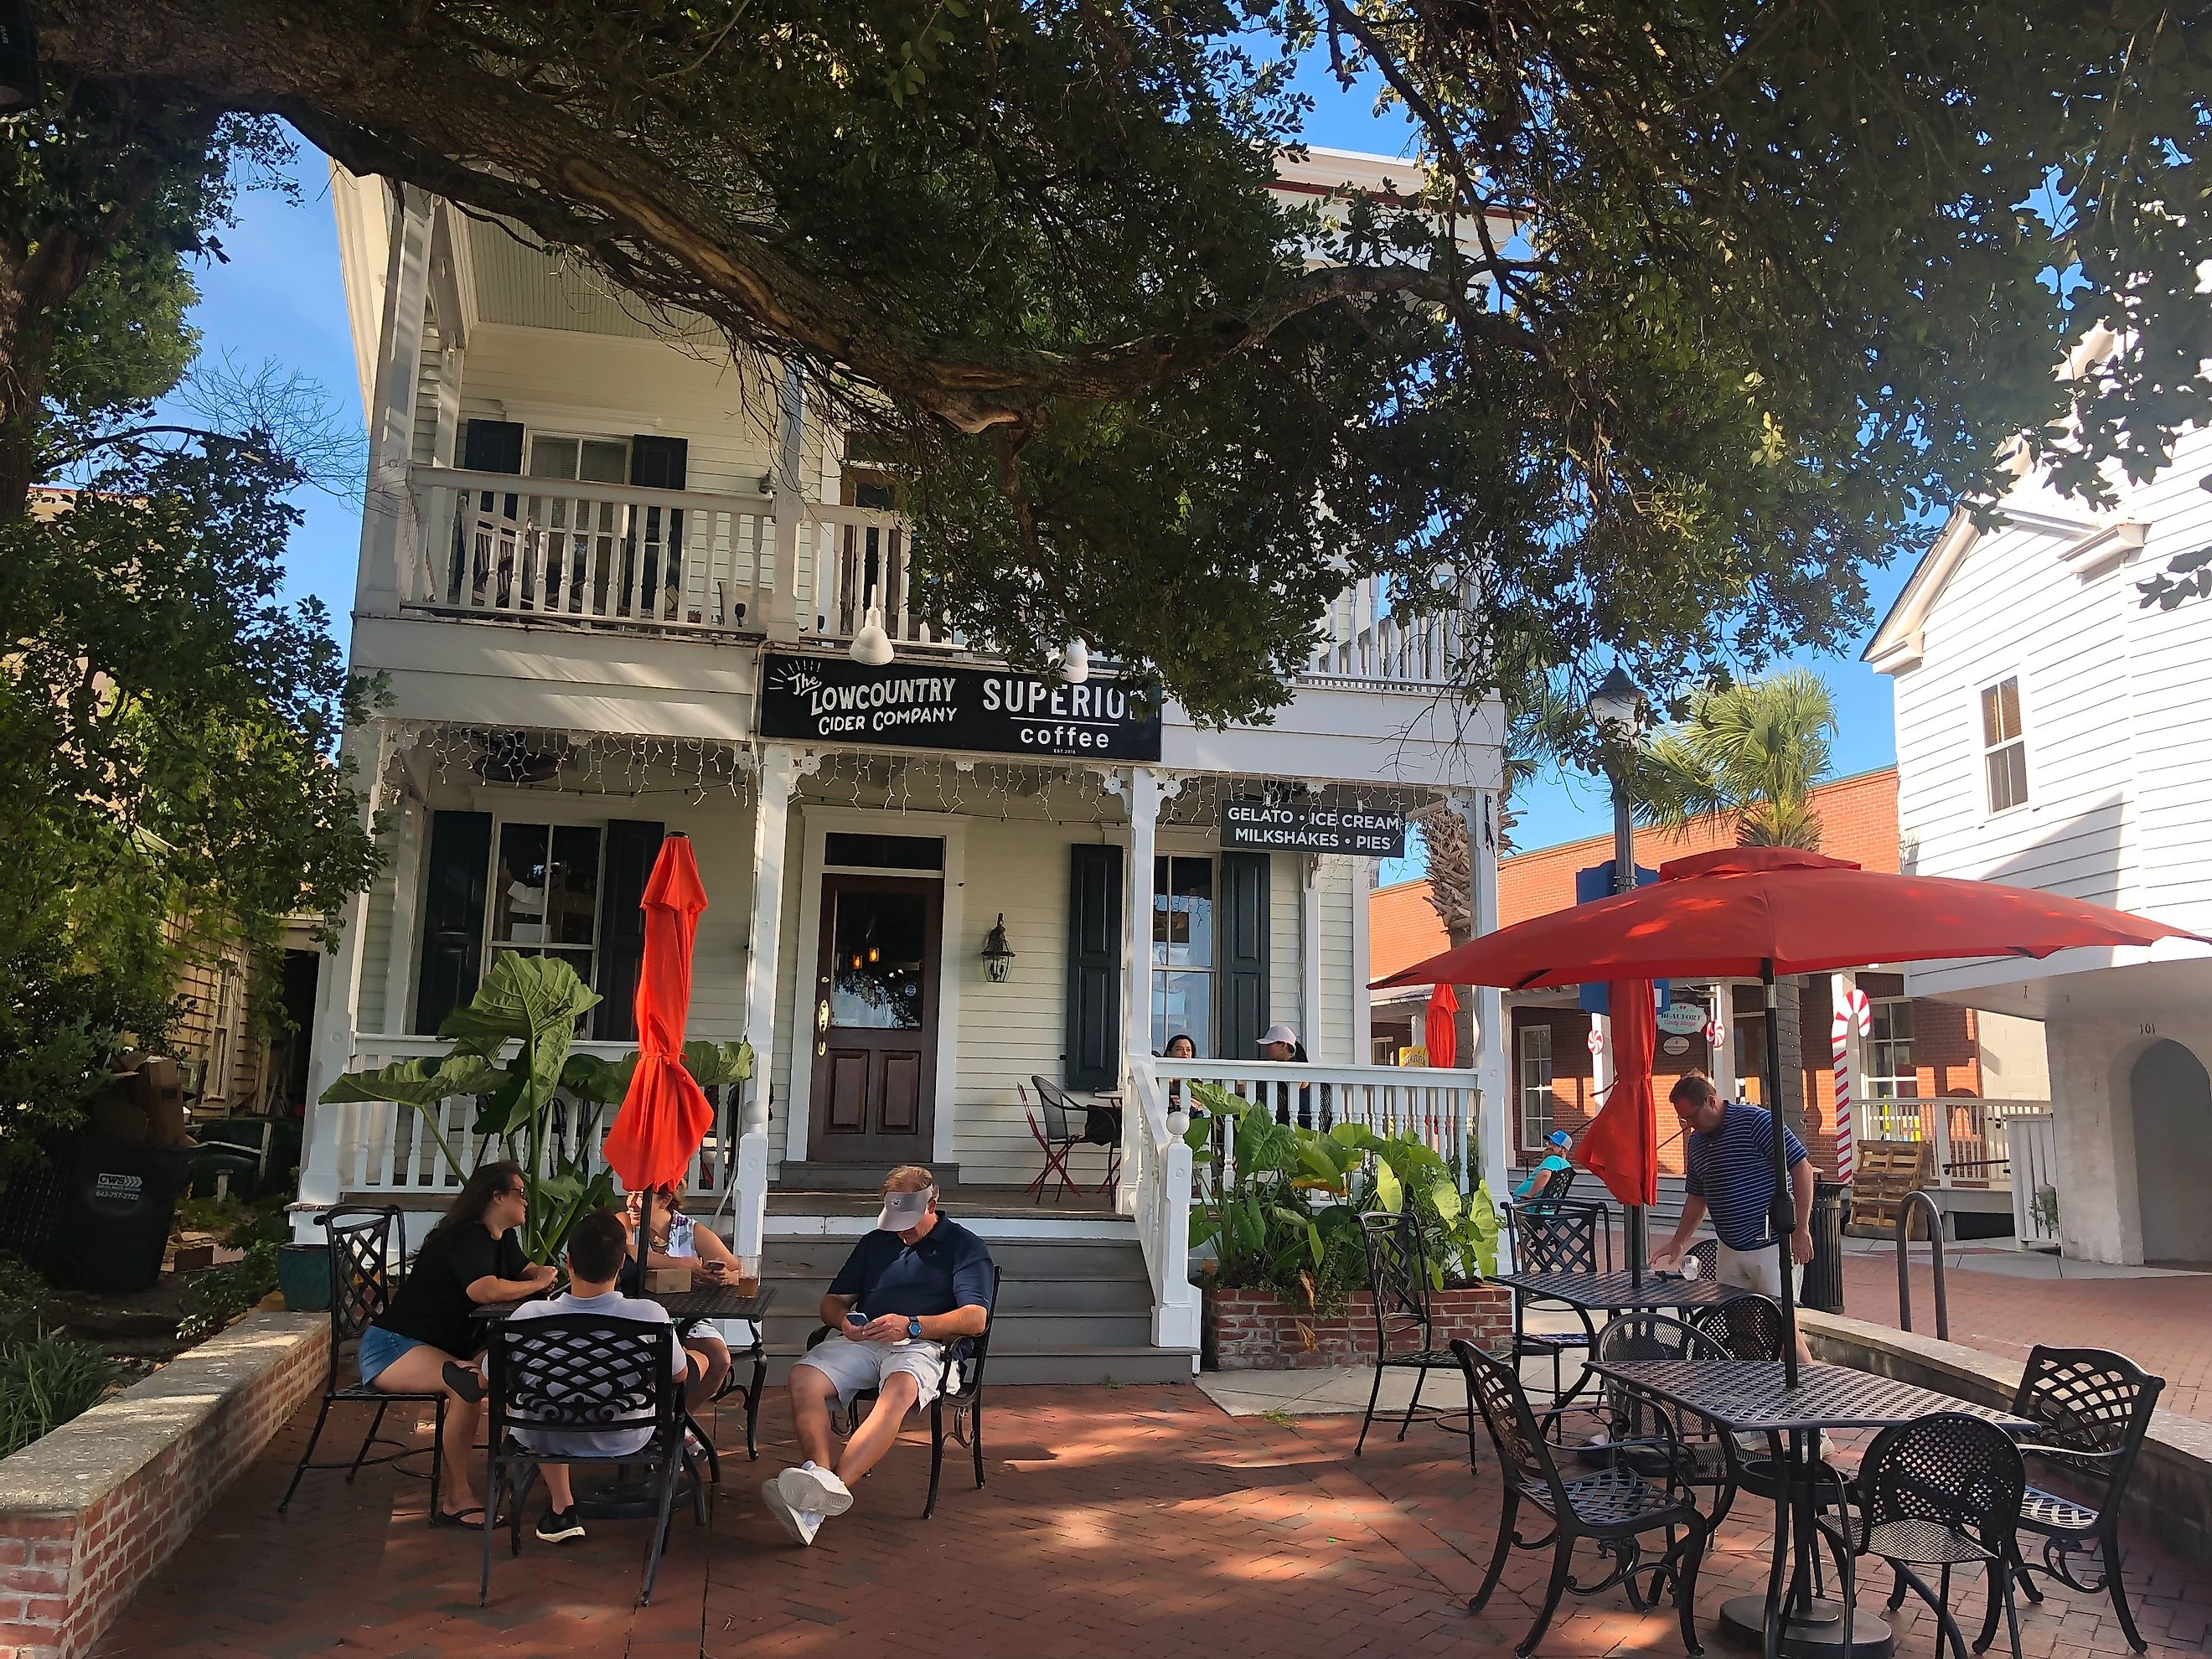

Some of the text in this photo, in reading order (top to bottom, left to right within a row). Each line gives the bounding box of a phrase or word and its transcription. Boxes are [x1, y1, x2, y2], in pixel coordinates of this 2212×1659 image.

[788, 673, 820, 695] The
[811, 678, 956, 716] LOWCOUNTRY
[819, 707, 957, 735] CIDER COMPANY
[1021, 726, 1109, 748] coffee
[1227, 807, 1400, 830] GELATO ICE CREAM
[1235, 828, 1391, 850] MILKSHAKES PIES
[2141, 1023, 2155, 1034] 101
[100, 1176, 126, 1186] CWS
